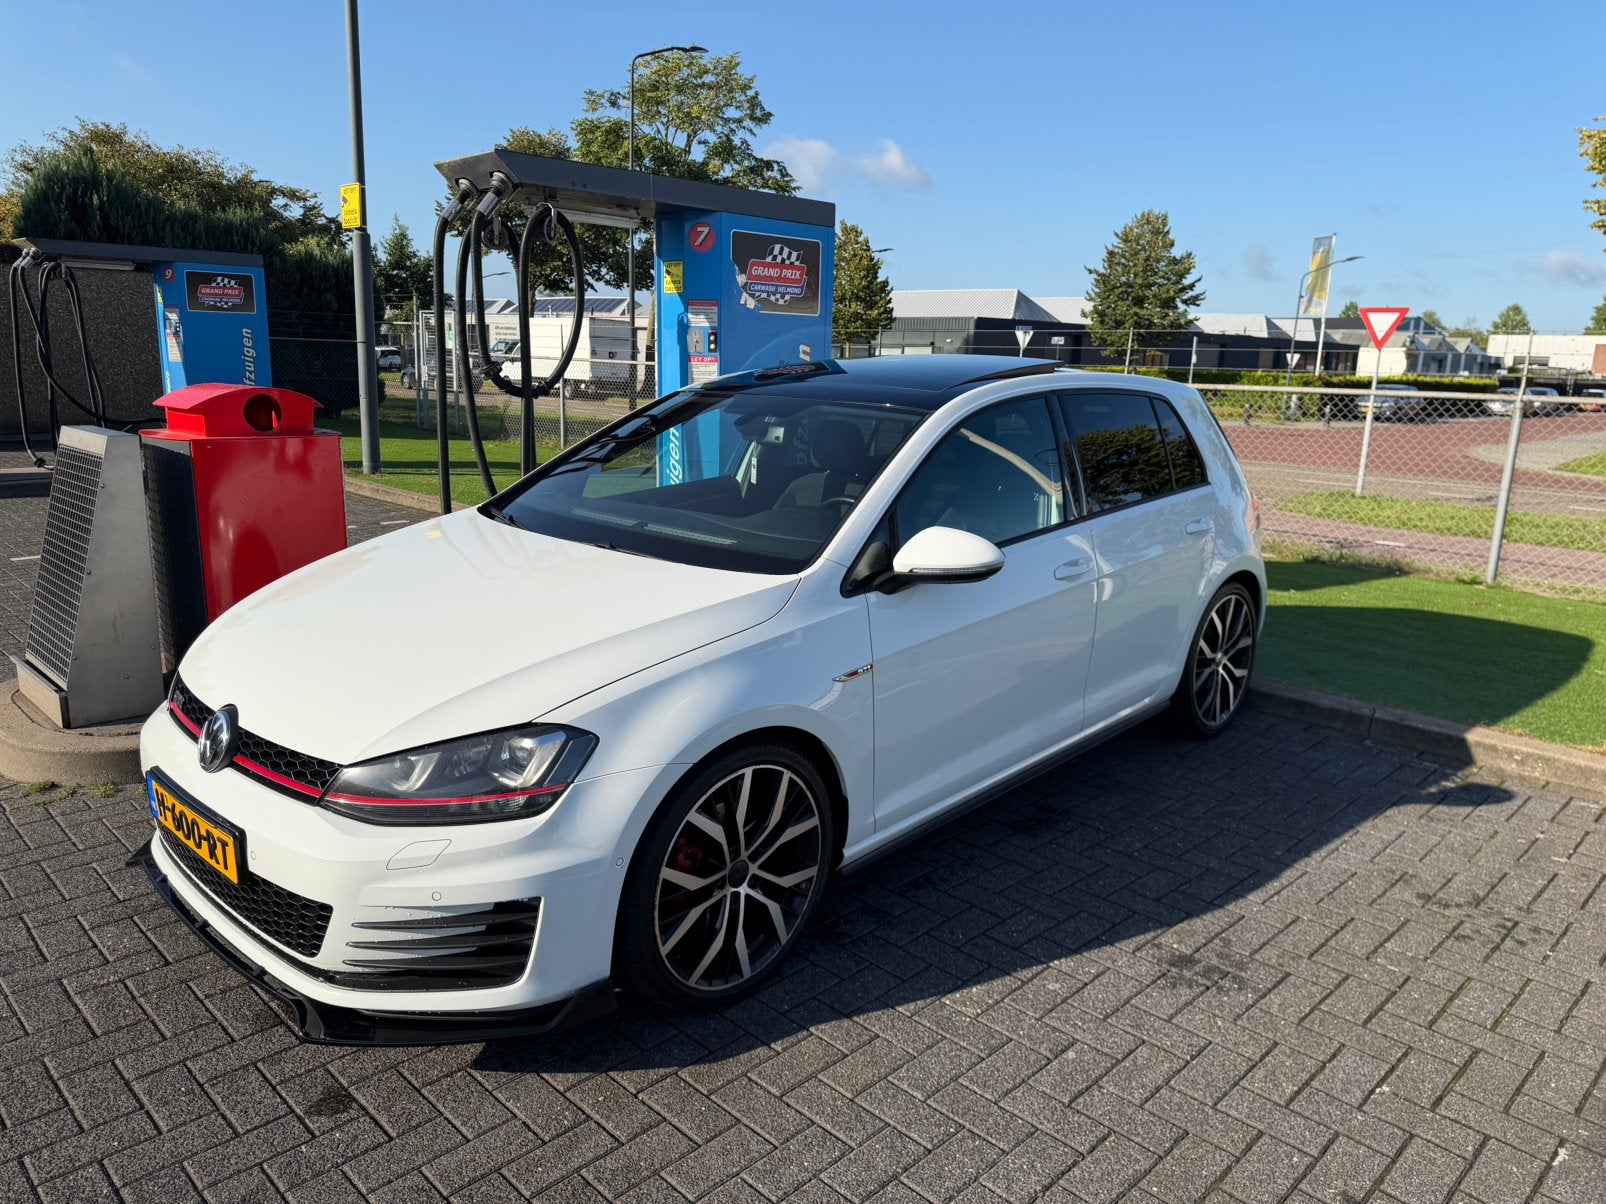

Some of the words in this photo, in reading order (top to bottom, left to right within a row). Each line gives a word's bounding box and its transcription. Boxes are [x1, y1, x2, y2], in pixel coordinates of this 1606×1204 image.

[694, 226, 711, 246] 7
[165, 269, 173, 279] 9
[751, 266, 780, 278] GRAND
[781, 269, 802, 279] PRIX
[750, 284, 776, 292] CARWASH
